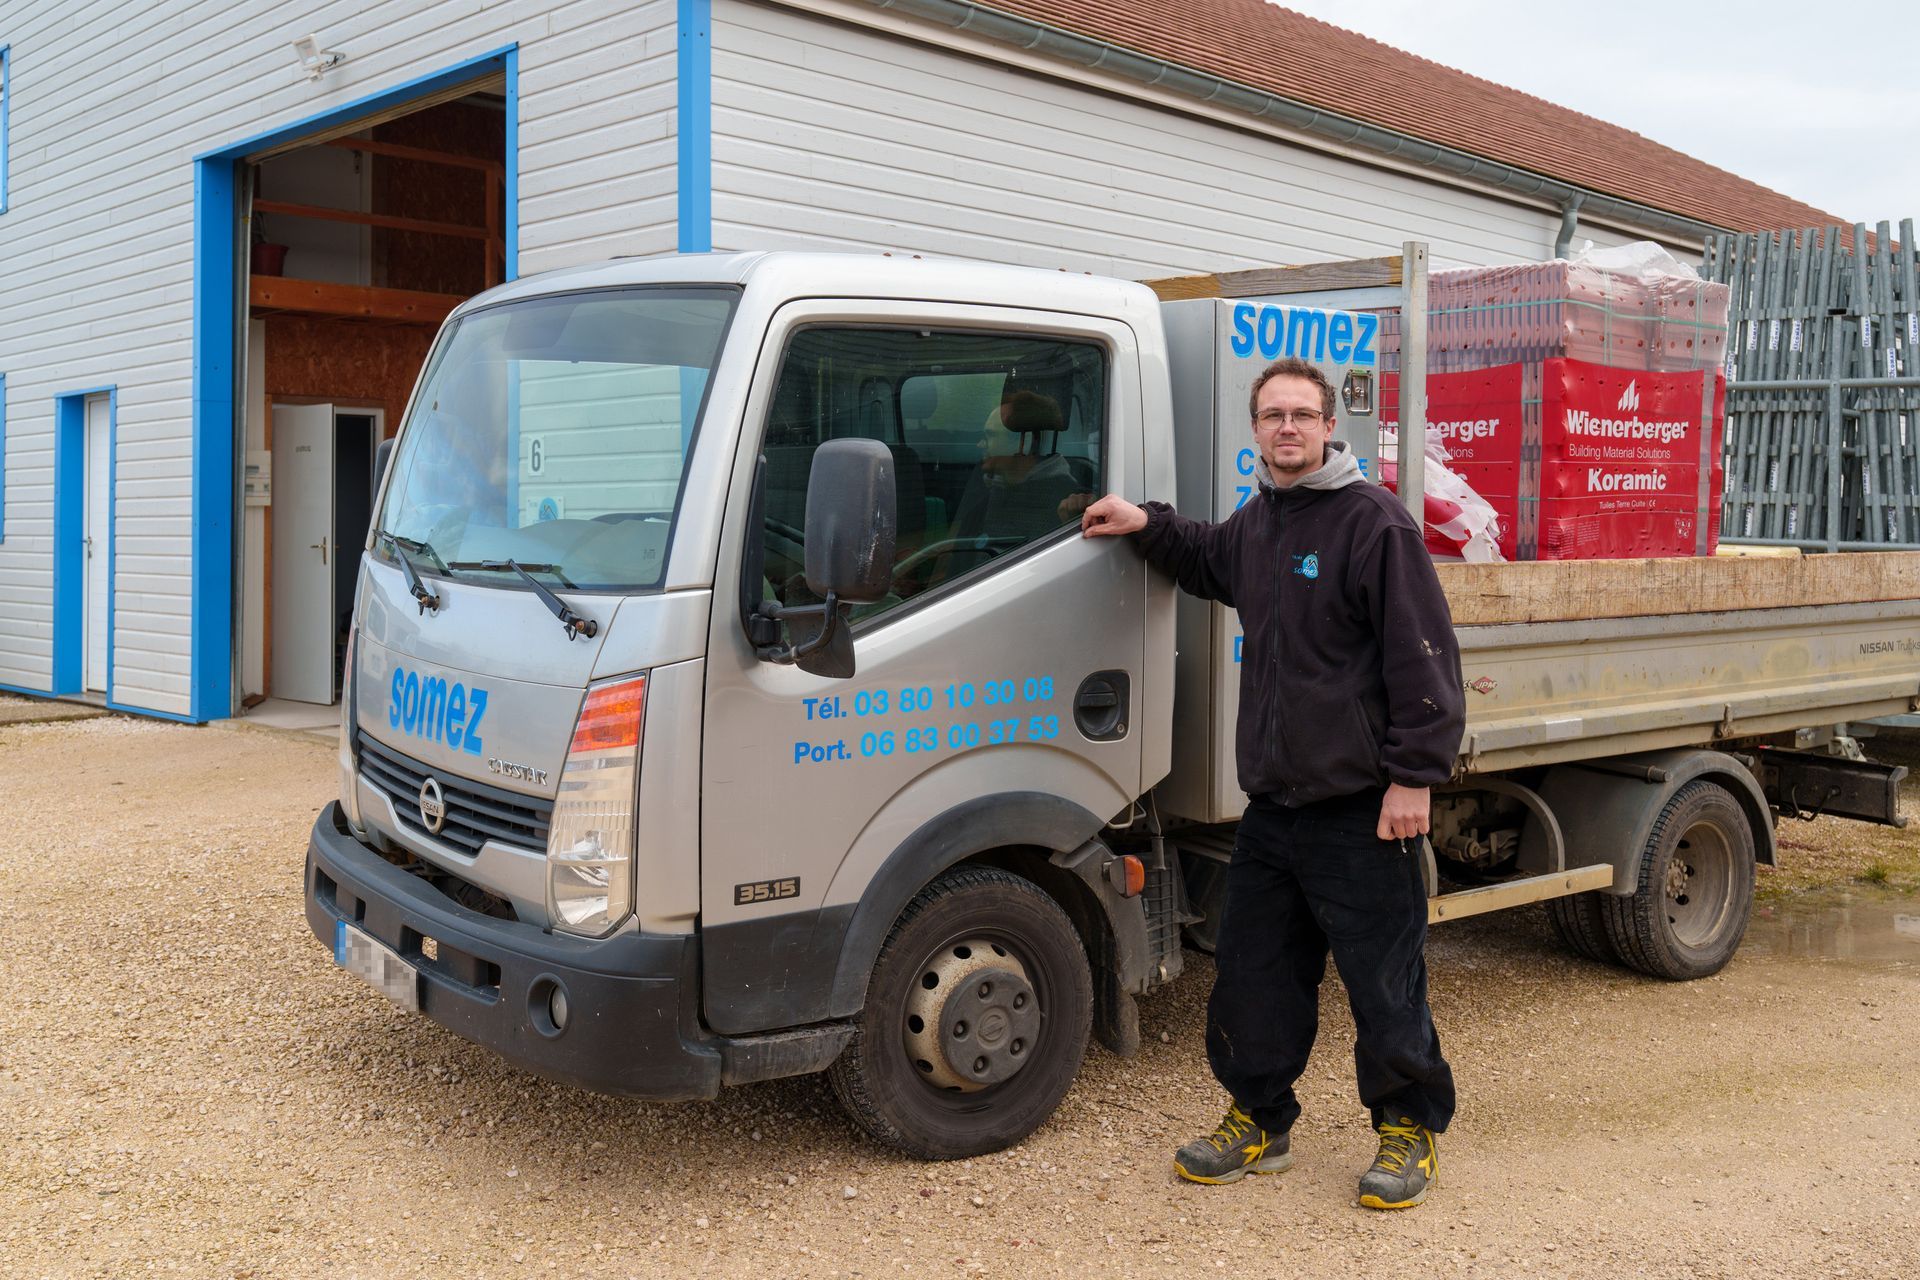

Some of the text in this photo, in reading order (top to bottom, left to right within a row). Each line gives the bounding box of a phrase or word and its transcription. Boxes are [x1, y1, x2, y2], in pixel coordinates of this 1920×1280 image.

[1231, 301, 1378, 366] somez
[1567, 408, 1689, 444] Wienerberger
[531, 439, 541, 472] 6
[1569, 443, 1671, 460] Building Material Solutions
[1587, 468, 1667, 493] Koramic
[1860, 640, 1894, 655] NISSAN
[389, 667, 489, 757] somez
[802, 676, 1055, 721] Tél. 03 80 10 30 08
[794, 715, 1060, 764] Port. 06 83 00 37 53
[488, 757, 548, 787] CABSTAR
[739, 879, 796, 903] 35.15
